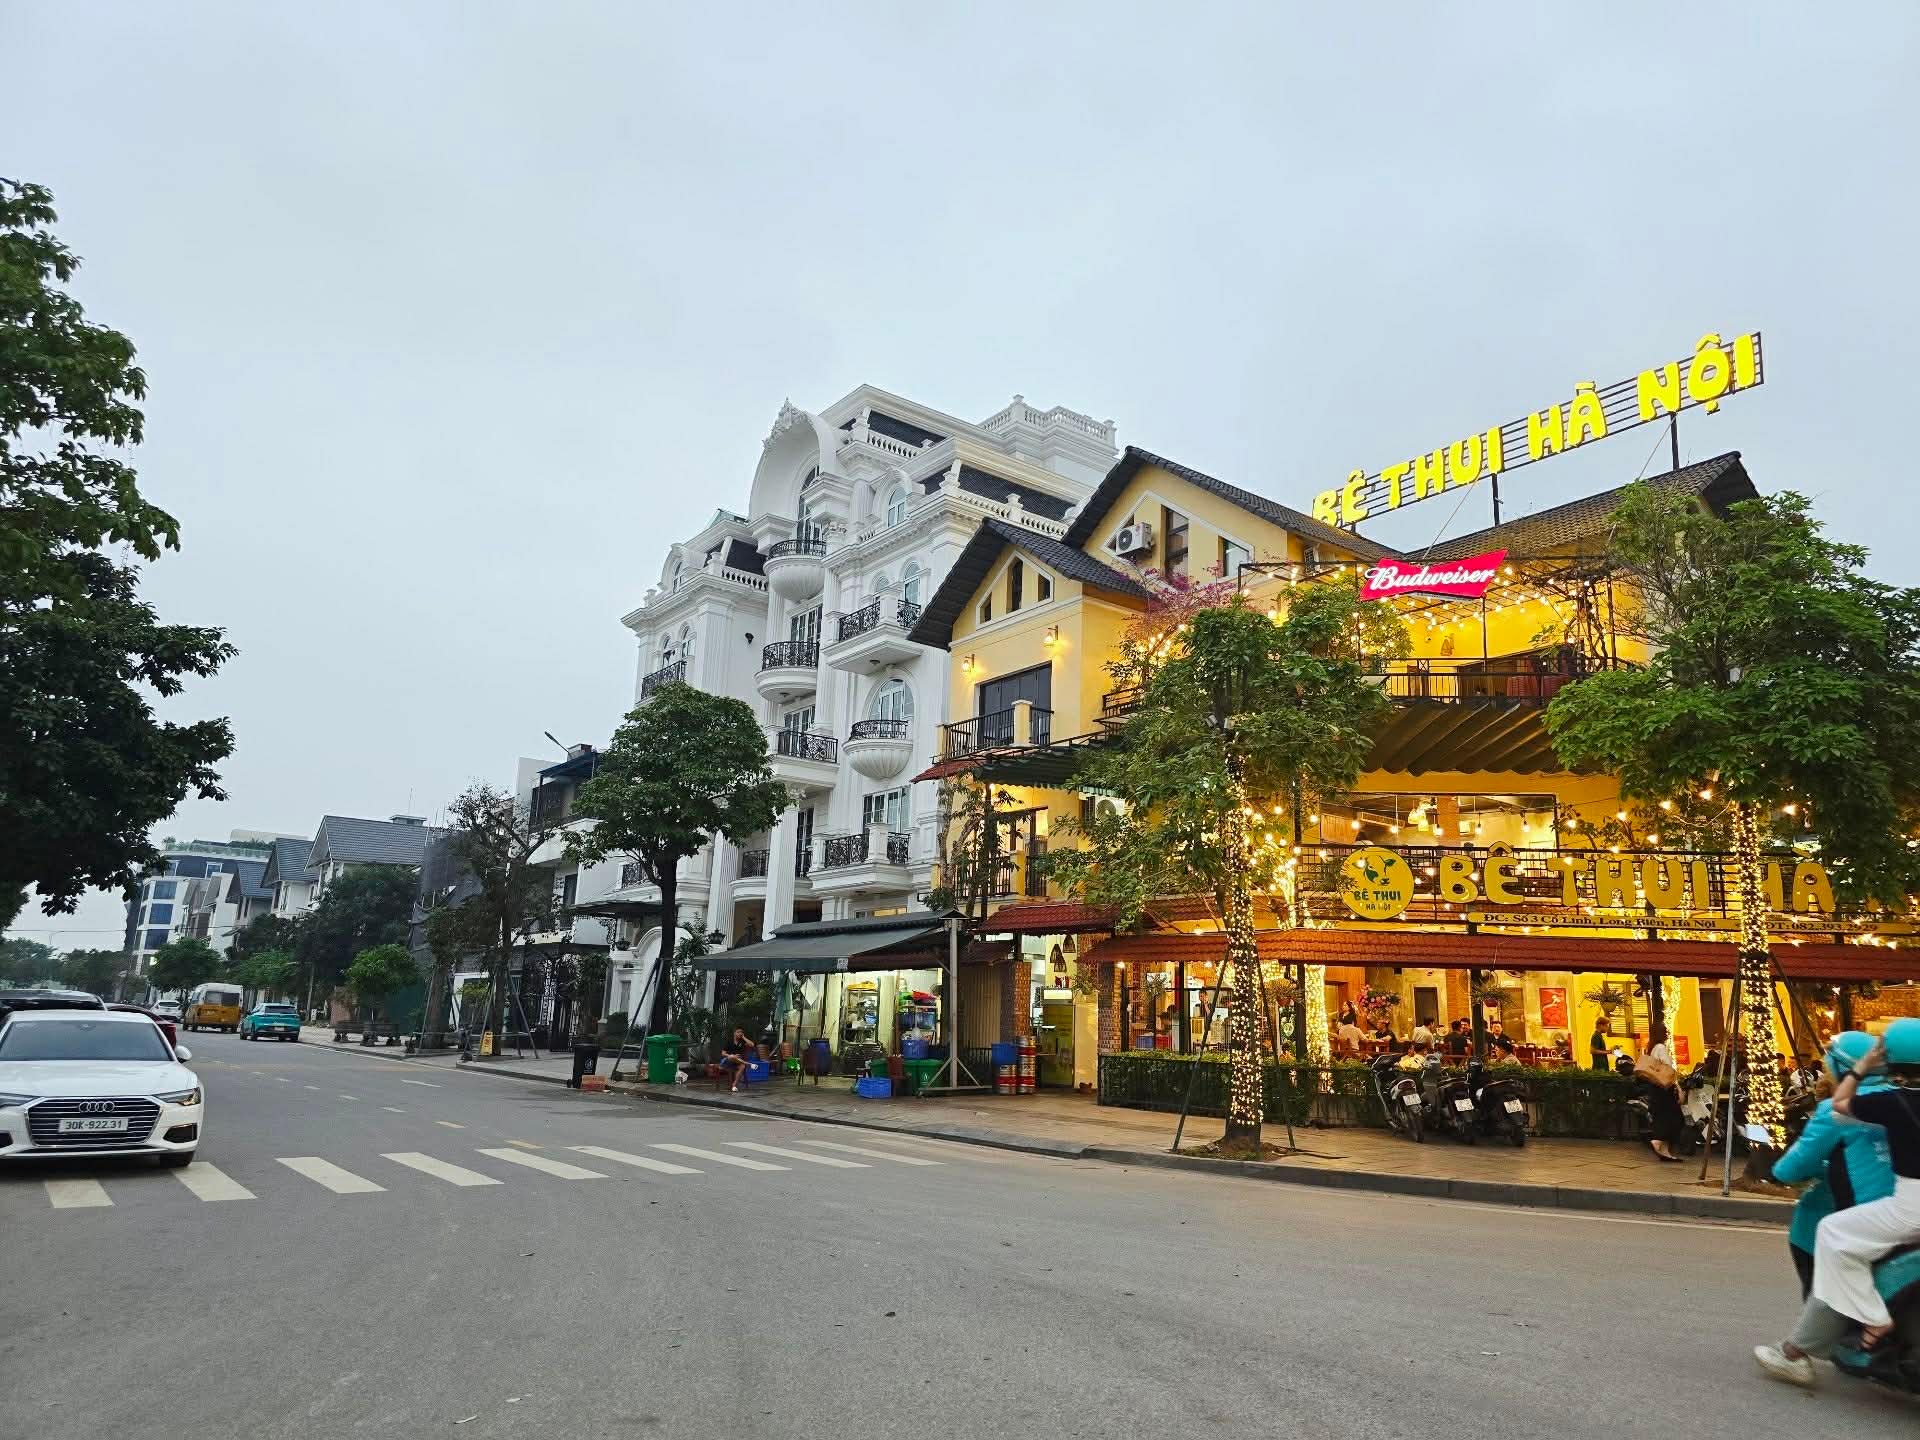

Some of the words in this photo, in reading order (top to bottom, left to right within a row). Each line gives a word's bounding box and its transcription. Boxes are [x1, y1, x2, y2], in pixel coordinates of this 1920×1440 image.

[1313, 469, 1370, 526] BÊ
[1380, 426, 1505, 509] THUI
[1528, 381, 1608, 461] HÀ
[1637, 334, 1756, 421] NỘI
[1364, 565, 1496, 591] Budweiser
[1439, 841, 1525, 905] BÊ
[1547, 857, 1710, 908] THUI
[1354, 888, 1369, 901] BÊ
[1373, 890, 1402, 901] THUI
[1484, 913, 1509, 922] ĐC:
[1530, 915, 1539, 923] 3
[1599, 917, 1632, 928] Long
